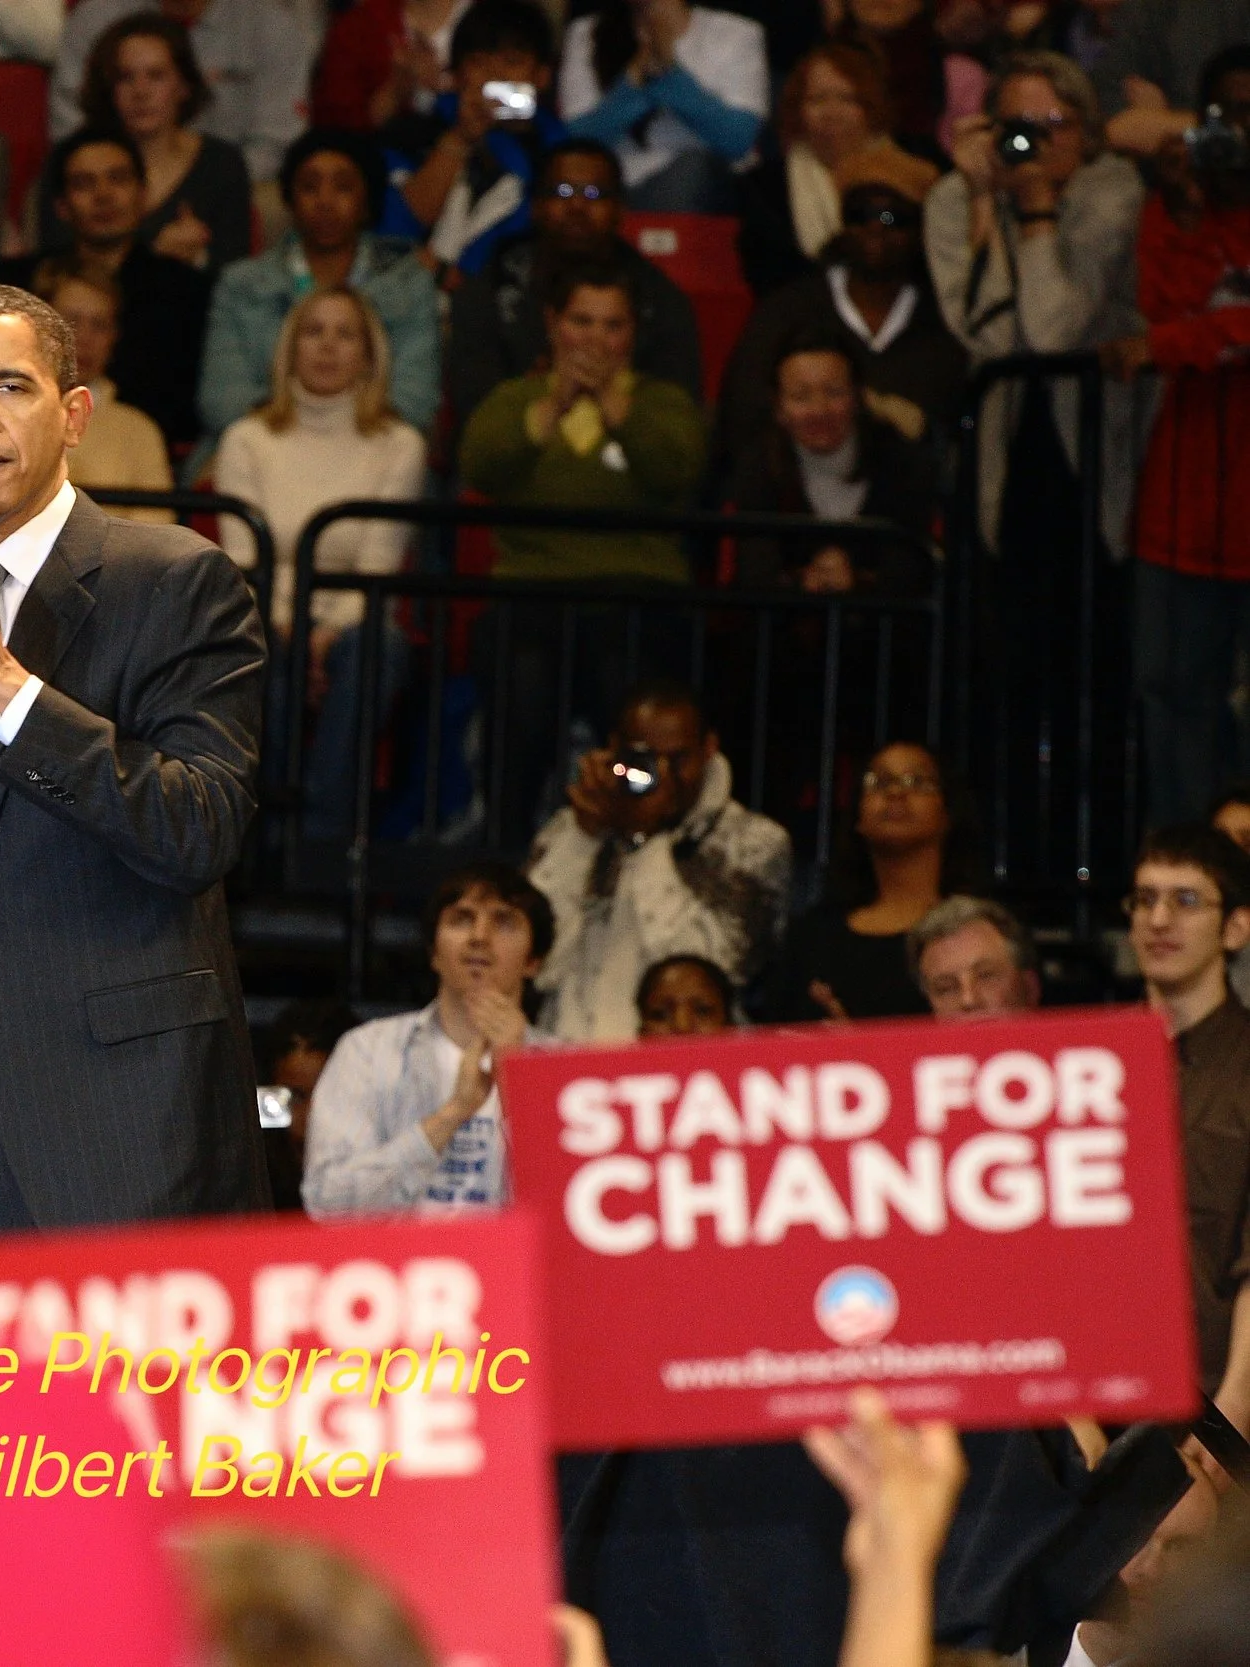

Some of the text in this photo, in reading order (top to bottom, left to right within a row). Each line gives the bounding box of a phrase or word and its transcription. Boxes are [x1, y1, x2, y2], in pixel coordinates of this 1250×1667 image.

[558, 1047, 1126, 1156] STAND FOR
[564, 1128, 1133, 1255] CHANGE
[250, 1257, 482, 1352] FOR
